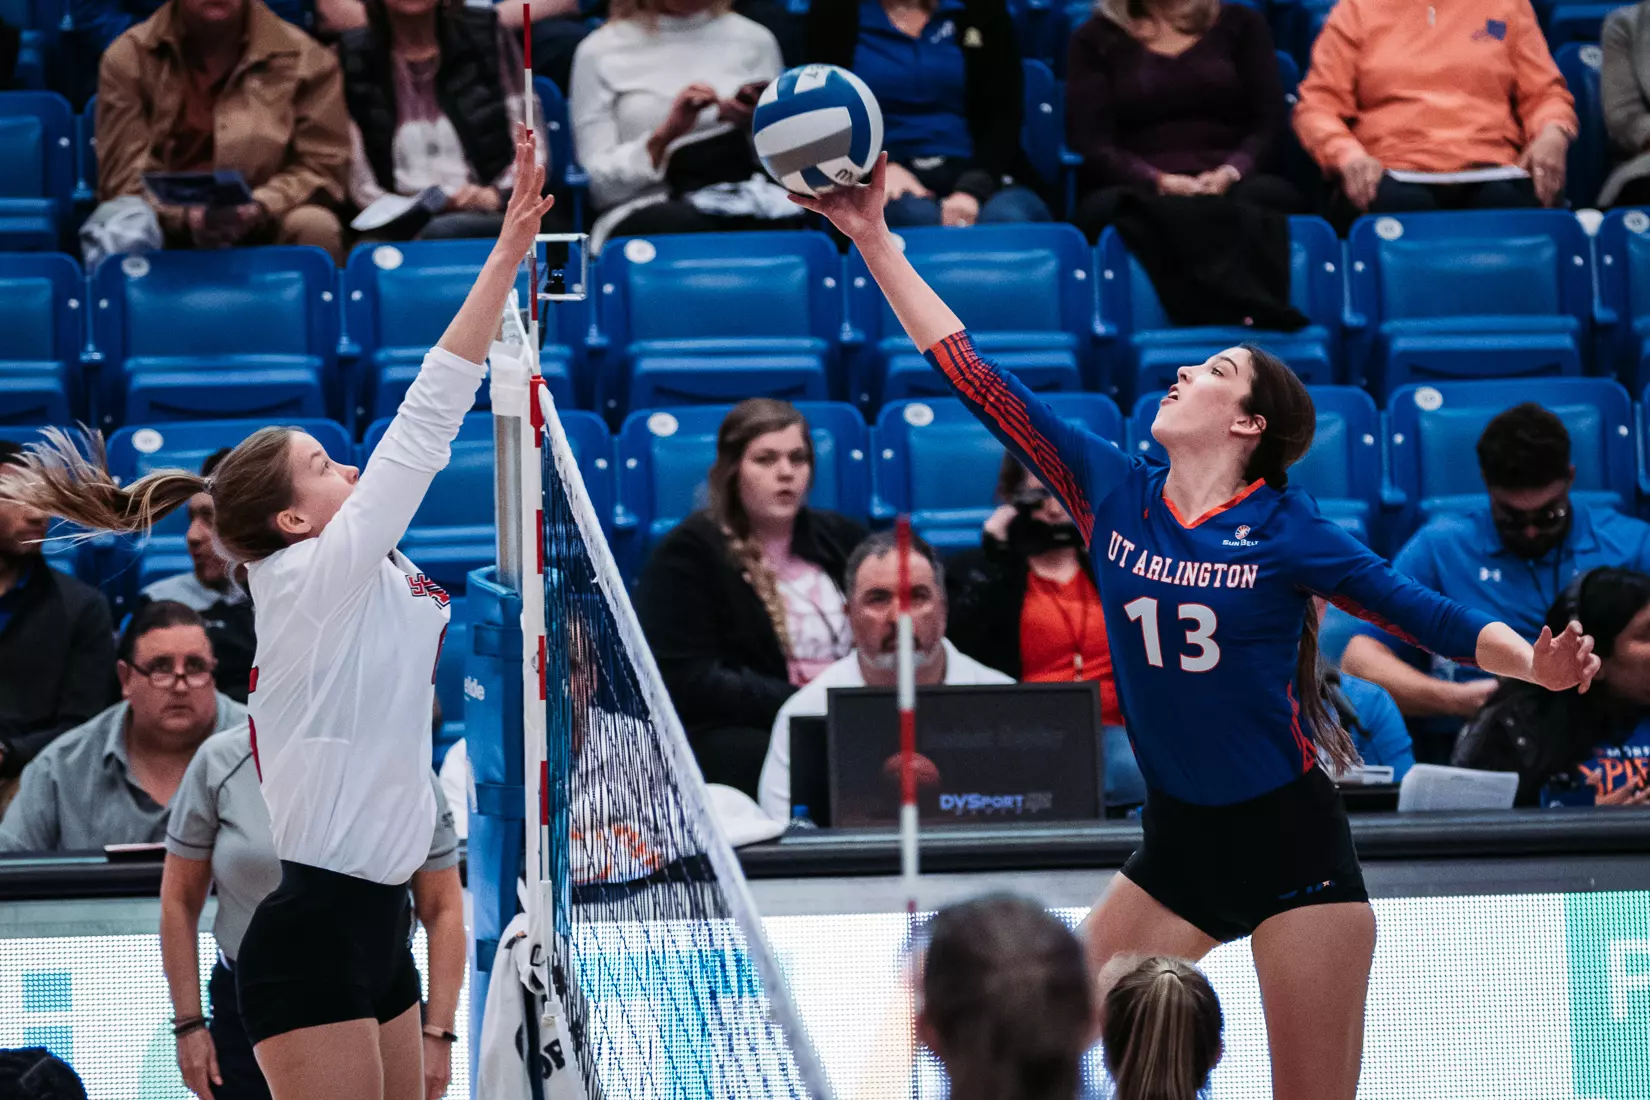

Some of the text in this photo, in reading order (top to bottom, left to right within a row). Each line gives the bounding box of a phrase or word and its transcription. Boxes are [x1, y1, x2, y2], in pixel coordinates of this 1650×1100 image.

[1107, 530, 1260, 589] UT ARLINGTON
[1222, 539, 1259, 547] SUN BELT
[1123, 596, 1222, 673] 13
